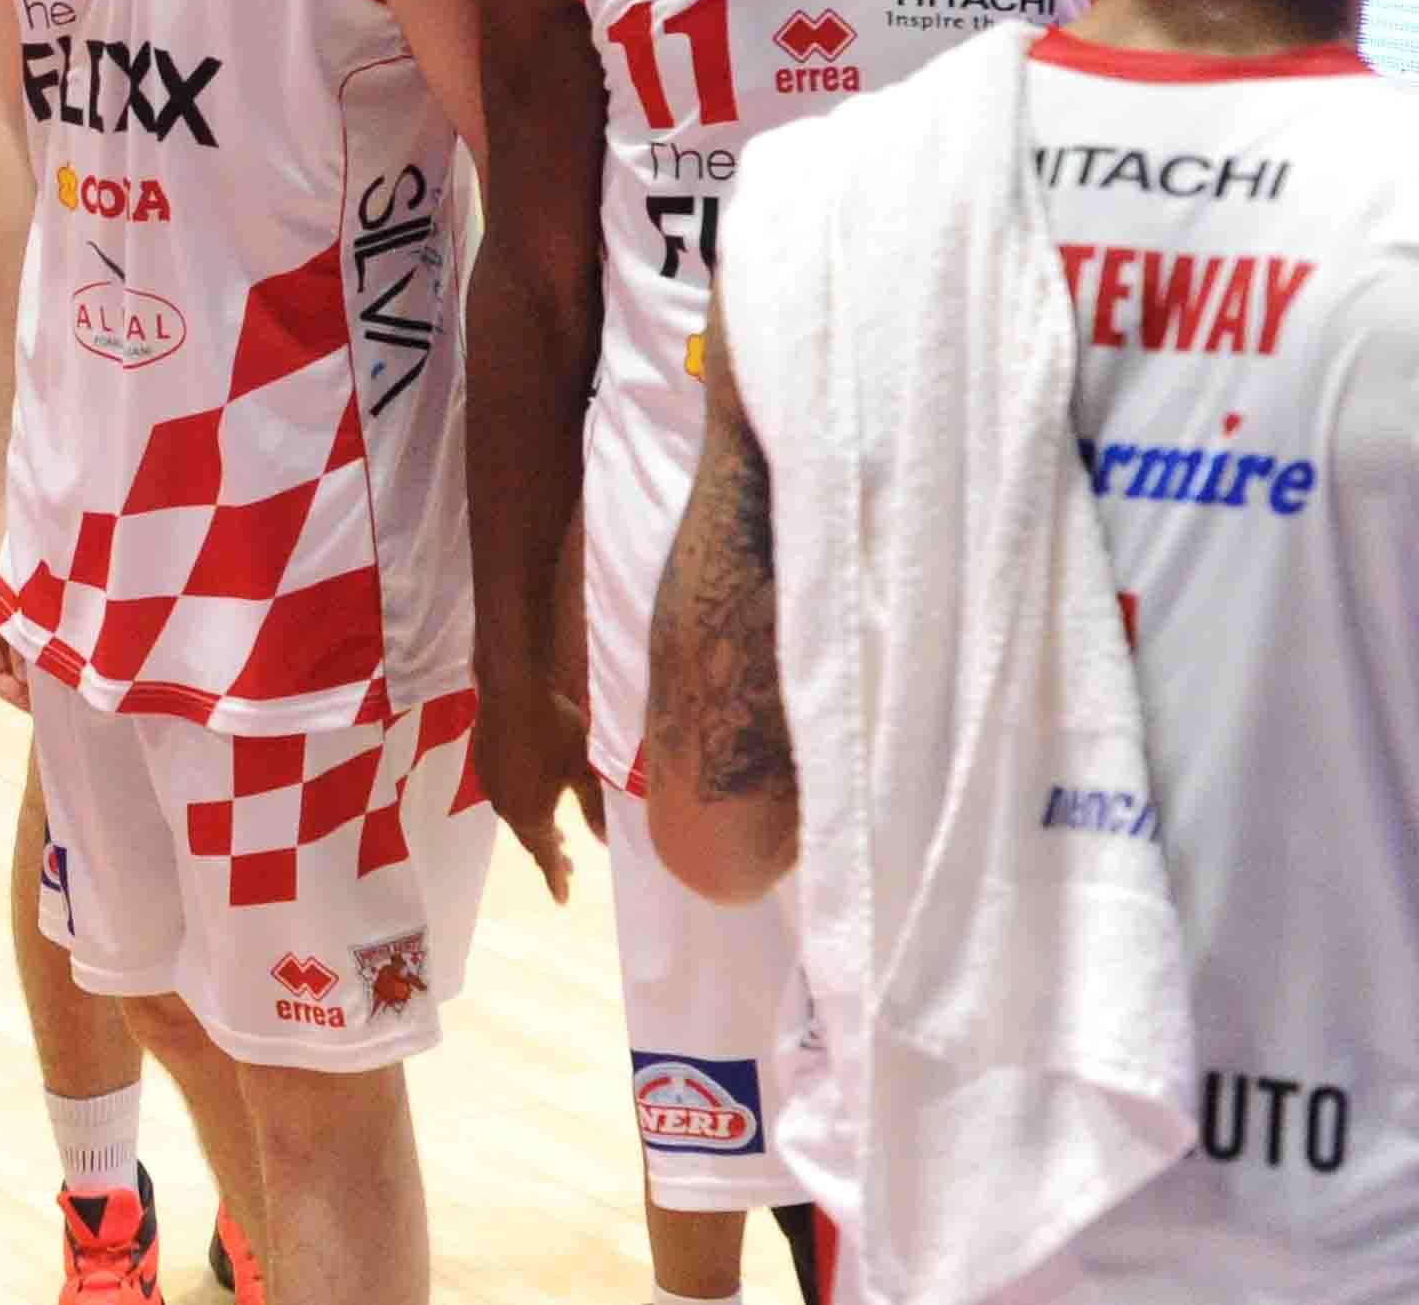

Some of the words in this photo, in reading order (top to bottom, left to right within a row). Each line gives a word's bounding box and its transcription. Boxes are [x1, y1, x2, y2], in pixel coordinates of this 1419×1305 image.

[774, 64, 861, 95] errea
[649, 141, 739, 182] The
[353, 163, 434, 417] SILVA
[274, 998, 347, 1029] errea
[640, 1105, 731, 1139] NERI
